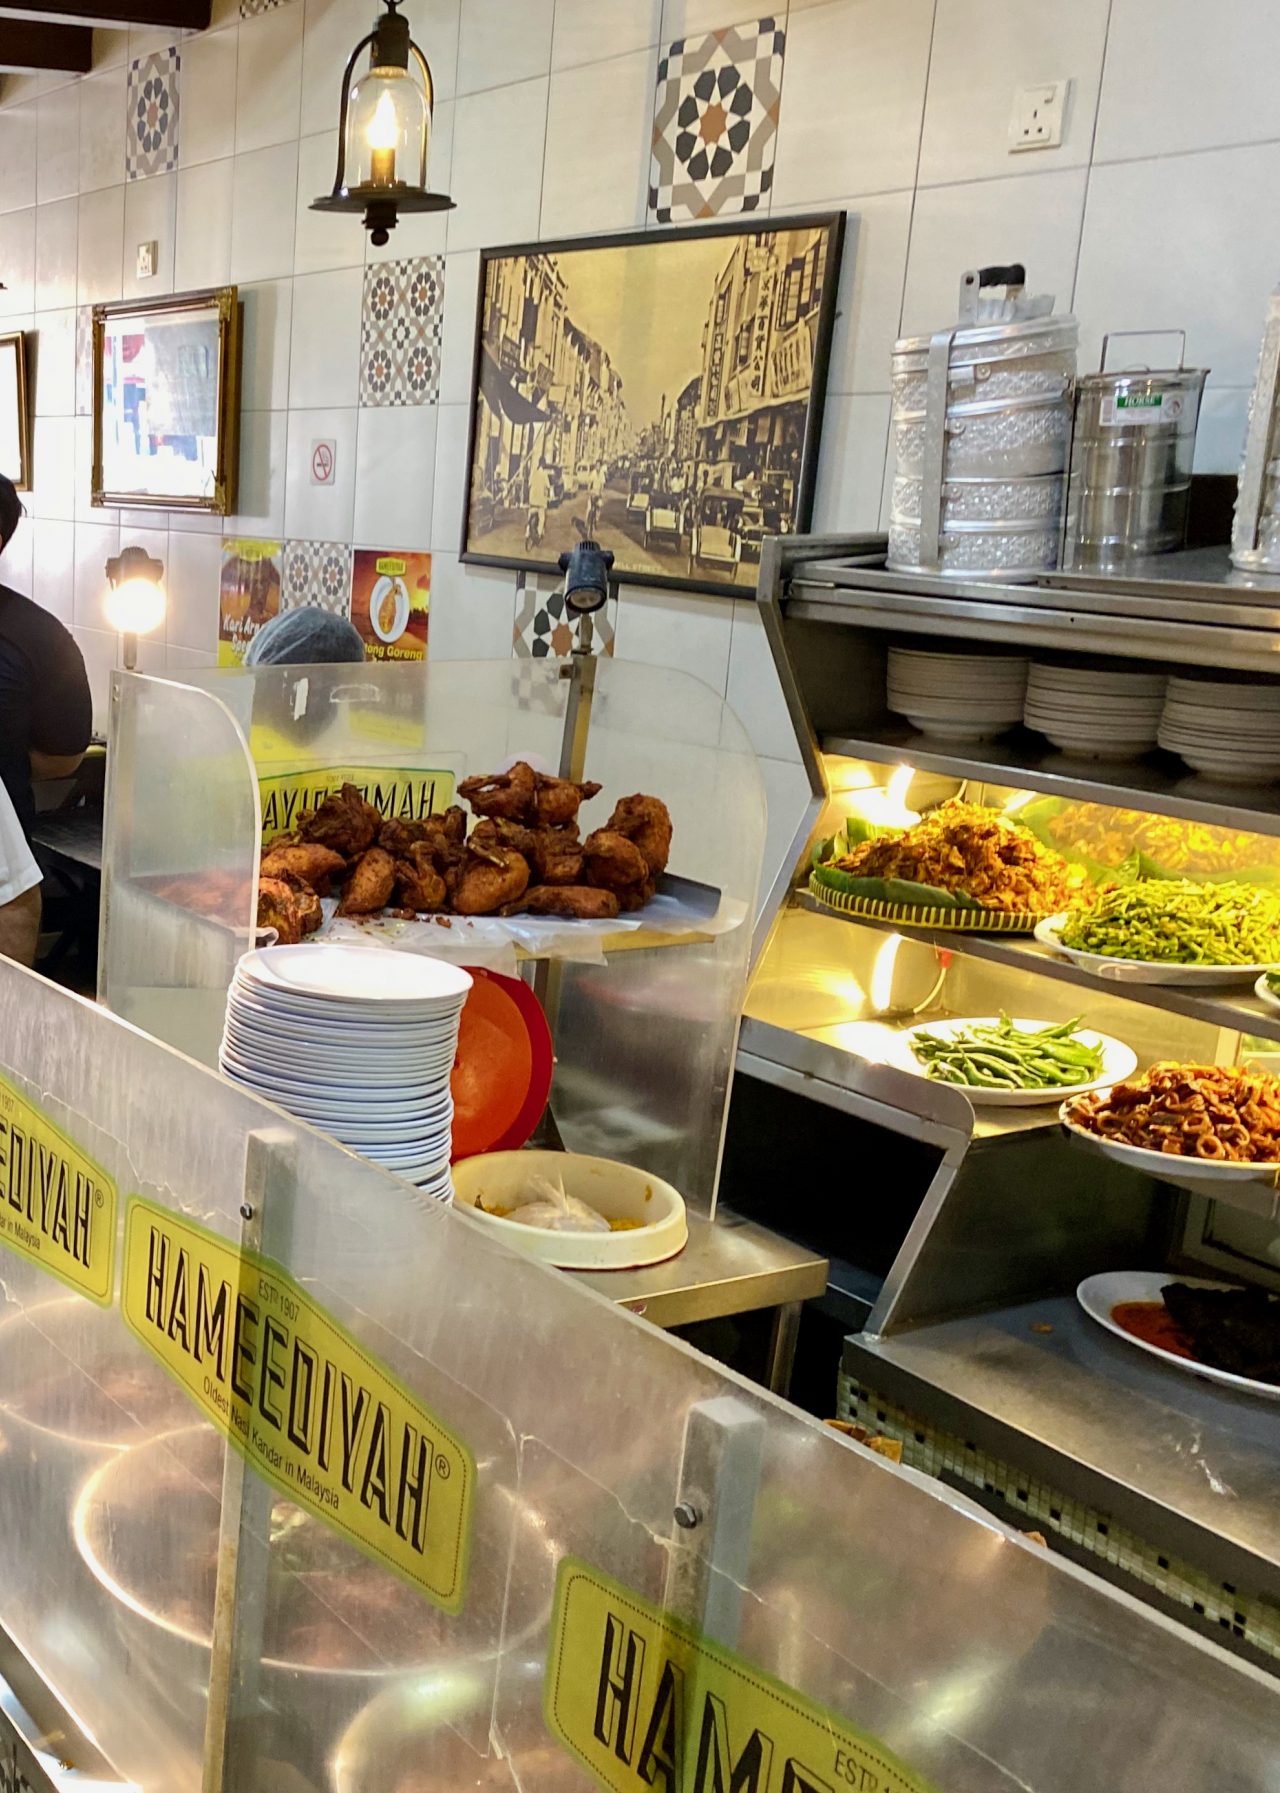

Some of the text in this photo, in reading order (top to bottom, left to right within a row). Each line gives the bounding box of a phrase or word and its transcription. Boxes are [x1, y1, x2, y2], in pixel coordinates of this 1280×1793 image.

[280, 1295, 300, 1323] 1907
[145, 1225, 434, 1555] HAMEEDIYAH
[203, 1376, 340, 1510] Oldest Nasi Kandar in Malaysia
[593, 1611, 837, 1793] HAM
